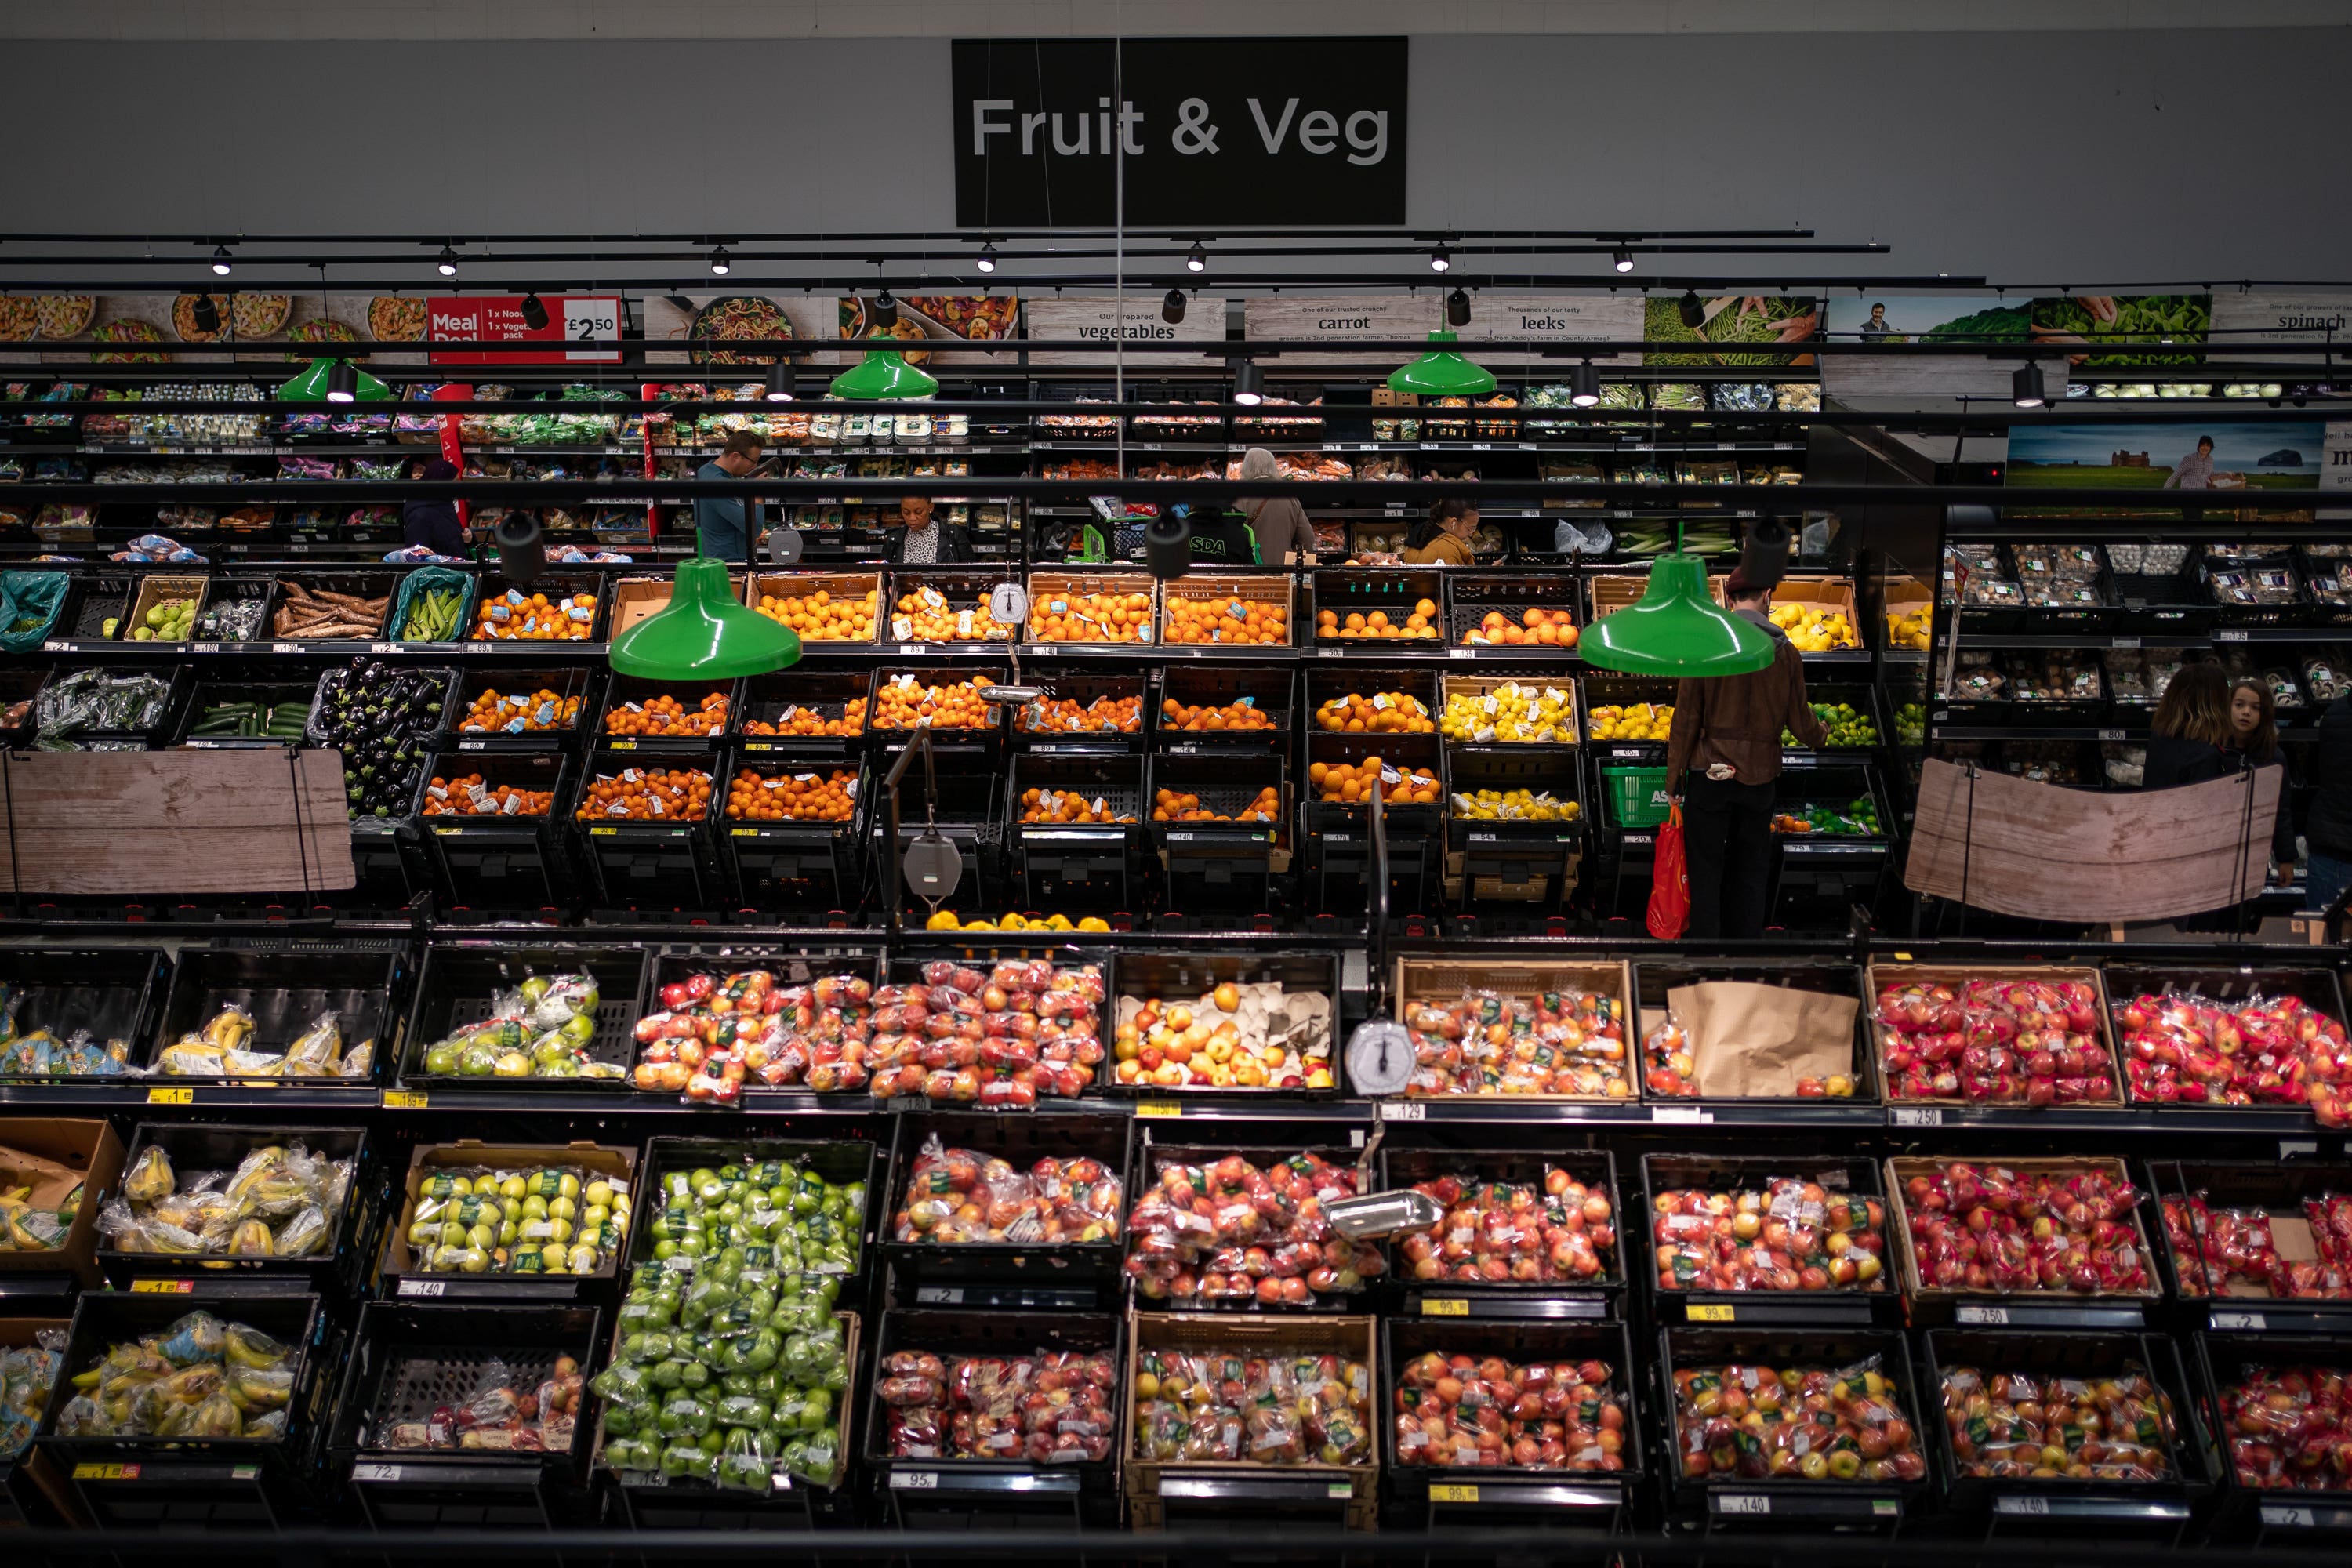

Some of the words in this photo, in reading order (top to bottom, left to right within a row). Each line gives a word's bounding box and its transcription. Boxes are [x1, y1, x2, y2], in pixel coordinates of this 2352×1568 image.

[972, 97, 1144, 155] Fruit
[1171, 97, 1220, 155] &
[1246, 98, 1388, 165] Veg
[488, 309, 492, 318] 1
[432, 313, 477, 331] Meal
[488, 321, 493, 331] 1
[1319, 317, 1370, 330] carrot
[1521, 316, 1566, 329] leeks
[2278, 313, 2346, 329] spinach
[503, 331, 524, 340] pack
[1079, 324, 1174, 341] vegetables
[1187, 536, 1226, 556] SDA
[168, 1089, 178, 1103] £1
[376, 1465, 395, 1480] 72p
[910, 1474, 931, 1488] 95p
